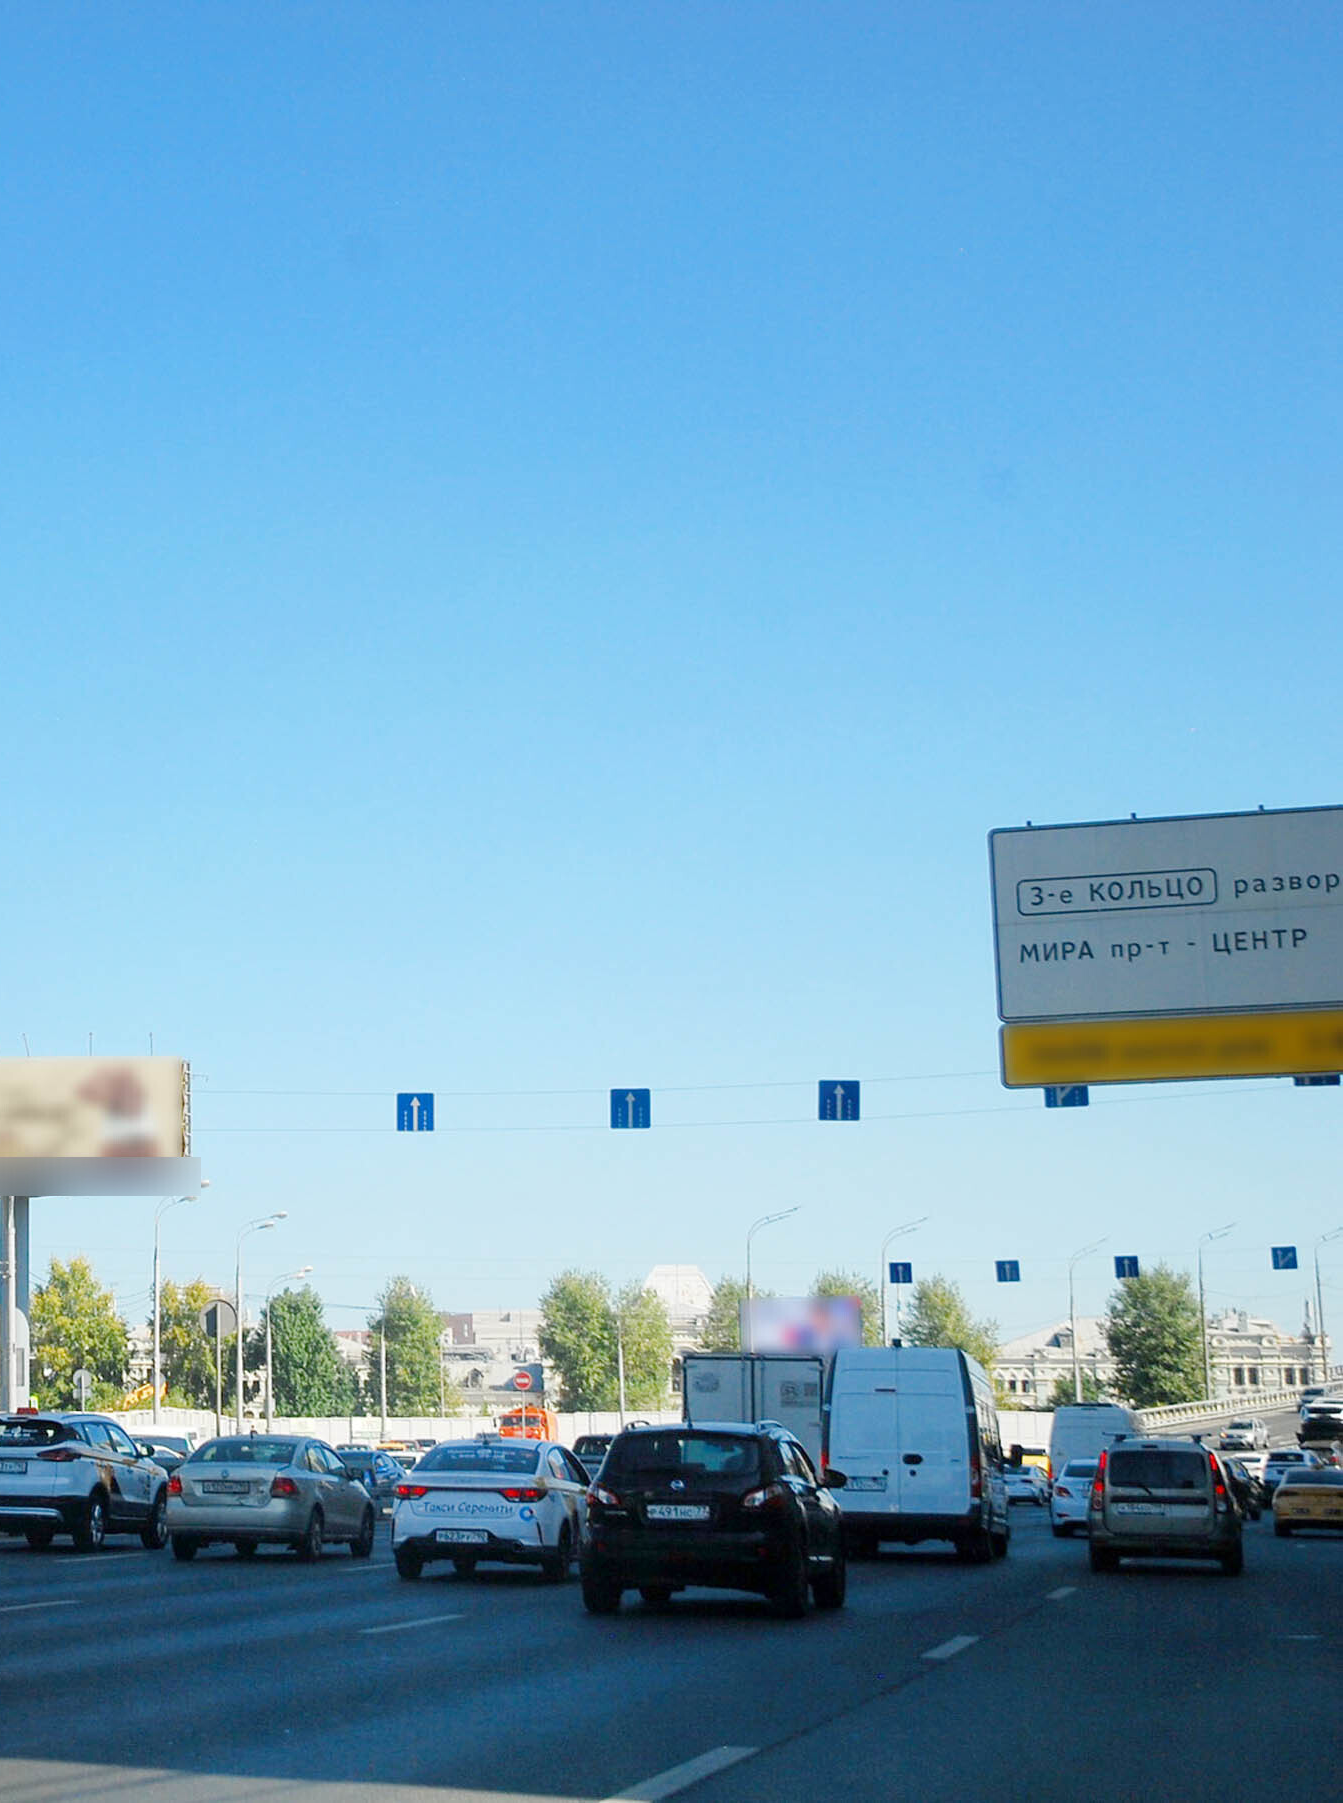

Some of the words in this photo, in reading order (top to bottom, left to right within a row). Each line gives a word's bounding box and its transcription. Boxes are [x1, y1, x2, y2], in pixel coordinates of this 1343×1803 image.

[1030, 885, 1073, 906] 3-е
[1089, 876, 1204, 902] КОЛЬЦО
[1019, 940, 1094, 963] МИРА
[1110, 940, 1170, 962] пр-т
[1212, 928, 1307, 955] ЦЕНТР
[423, 1502, 455, 1512] Такси
[457, 1502, 513, 1514] Серенити
